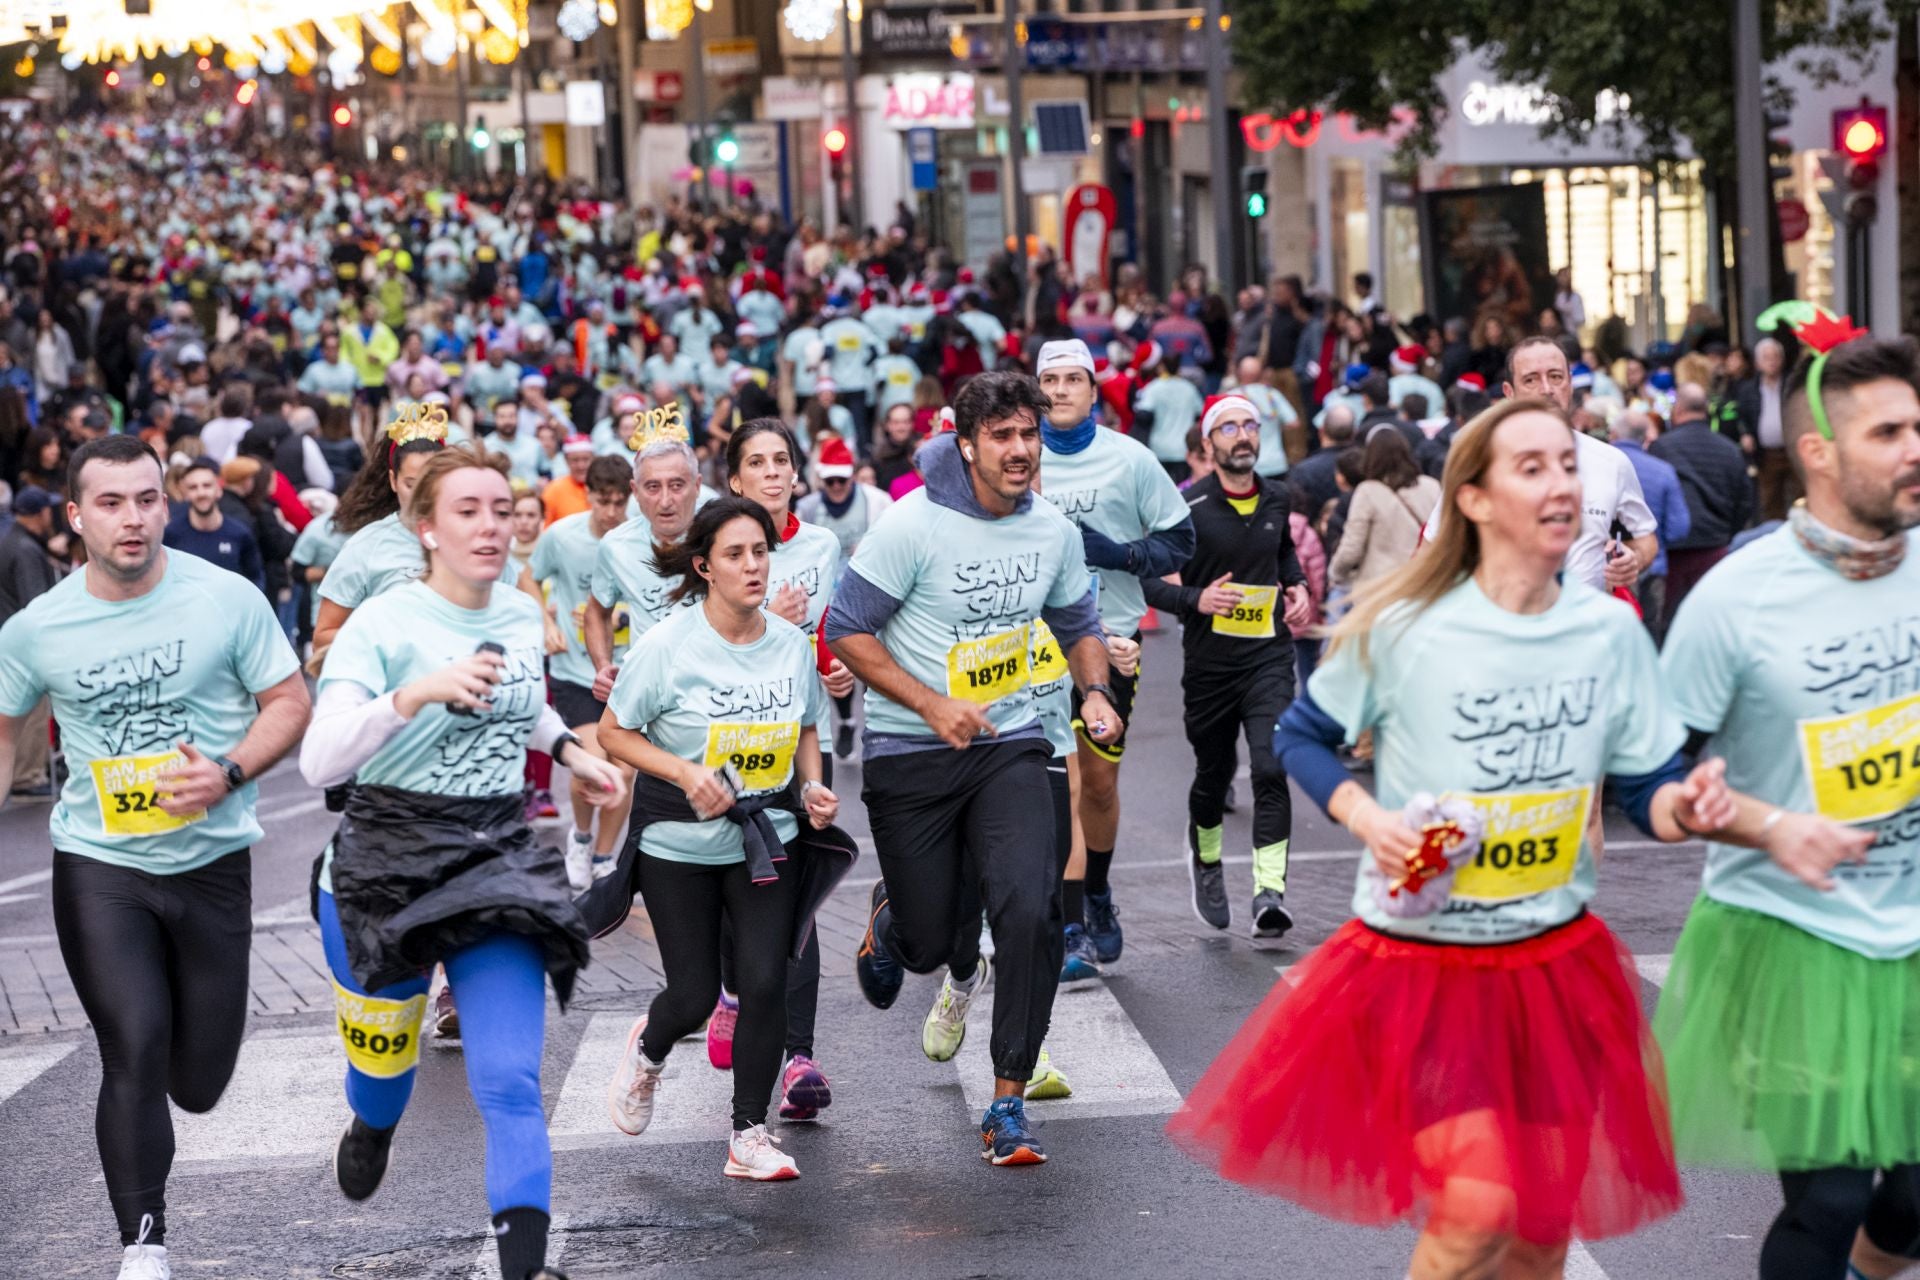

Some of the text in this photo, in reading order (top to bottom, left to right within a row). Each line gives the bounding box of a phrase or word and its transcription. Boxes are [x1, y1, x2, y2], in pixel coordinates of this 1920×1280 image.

[633, 401, 684, 434] 2025
[952, 552, 1040, 594] SAN
[960, 586, 1029, 624] SIL
[75, 639, 185, 703] SAN
[966, 658, 1017, 688] 1878
[708, 677, 793, 718] SAN
[1451, 676, 1597, 742] SAN
[716, 724, 794, 756] SILVESTRE
[718, 725, 750, 745] SAN
[730, 752, 776, 771] 989
[1472, 733, 1574, 793] SIL
[1475, 836, 1558, 870] 1083
